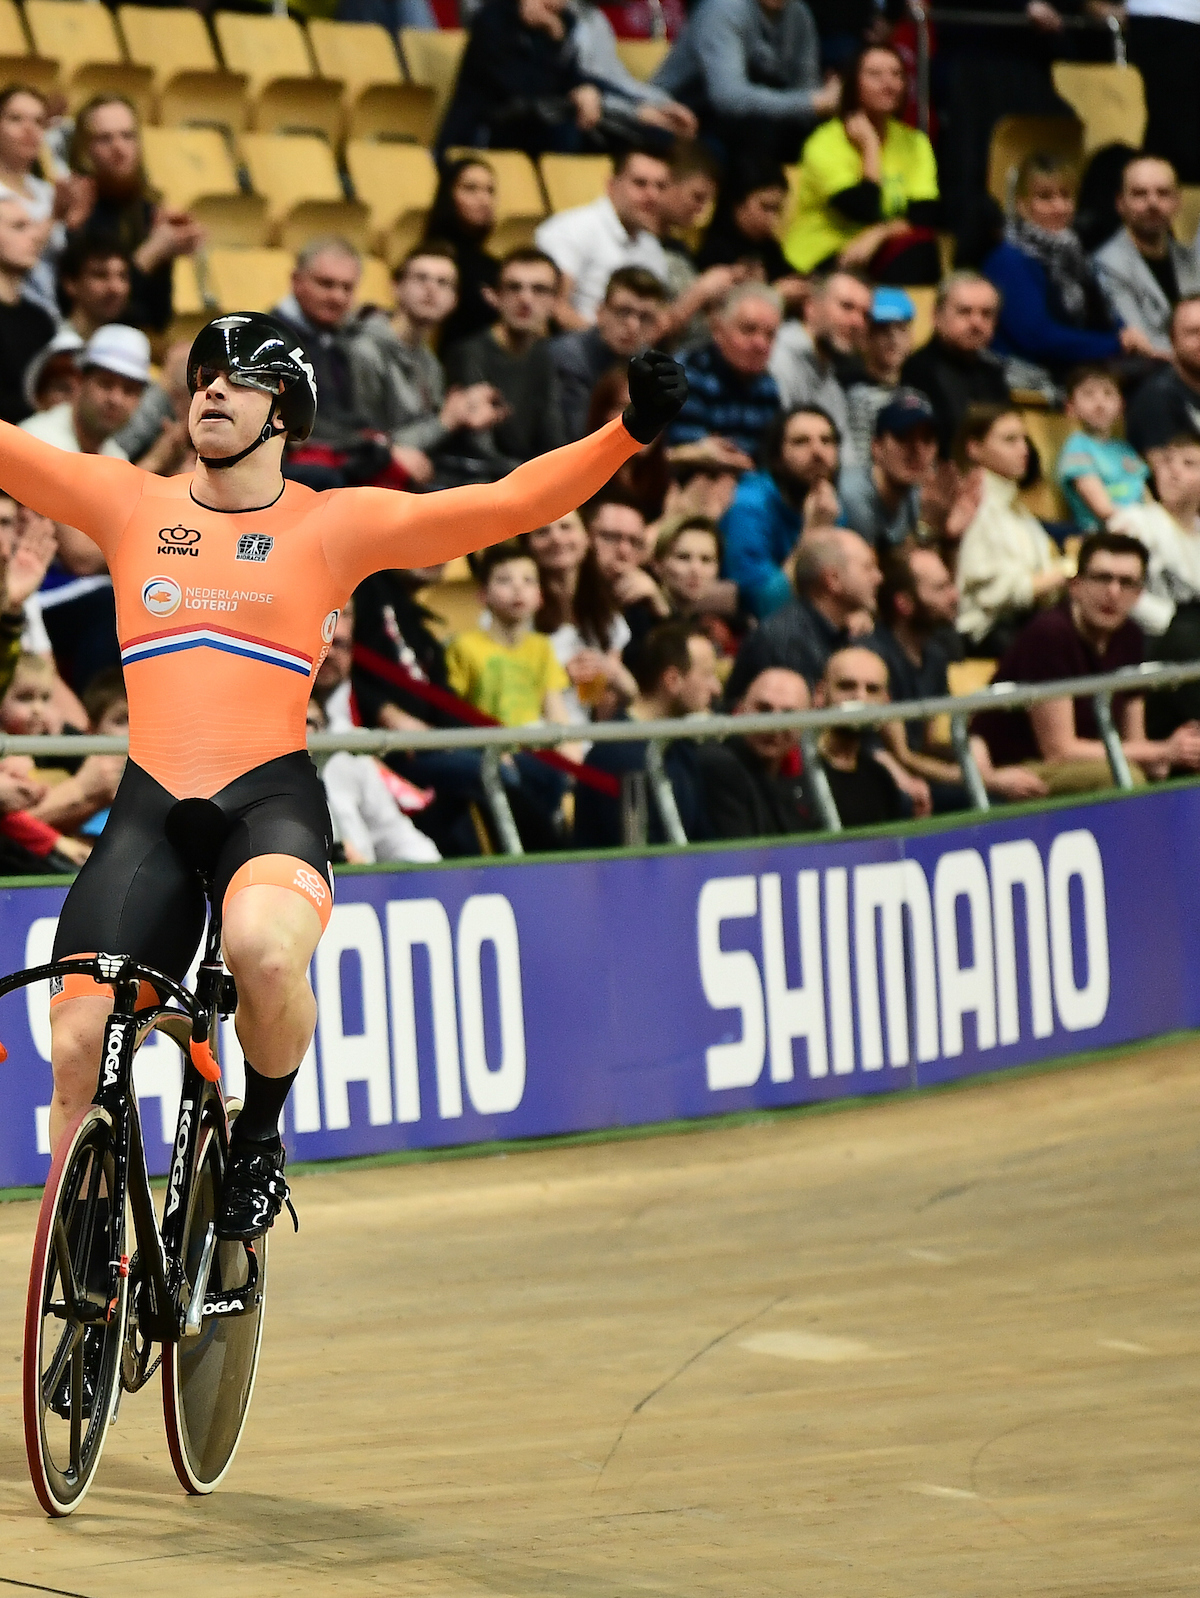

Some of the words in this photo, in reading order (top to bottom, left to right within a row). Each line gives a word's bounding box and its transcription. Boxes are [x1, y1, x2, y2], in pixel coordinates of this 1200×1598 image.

[185, 599, 238, 612] LOTERIJ
[186, 587, 274, 604] NEDERLANDSE
[698, 829, 1110, 1091] SHIMANO
[103, 1023, 126, 1087] KOGA
[166, 1100, 193, 1218] KOGA
[201, 1299, 245, 1315] OGA
